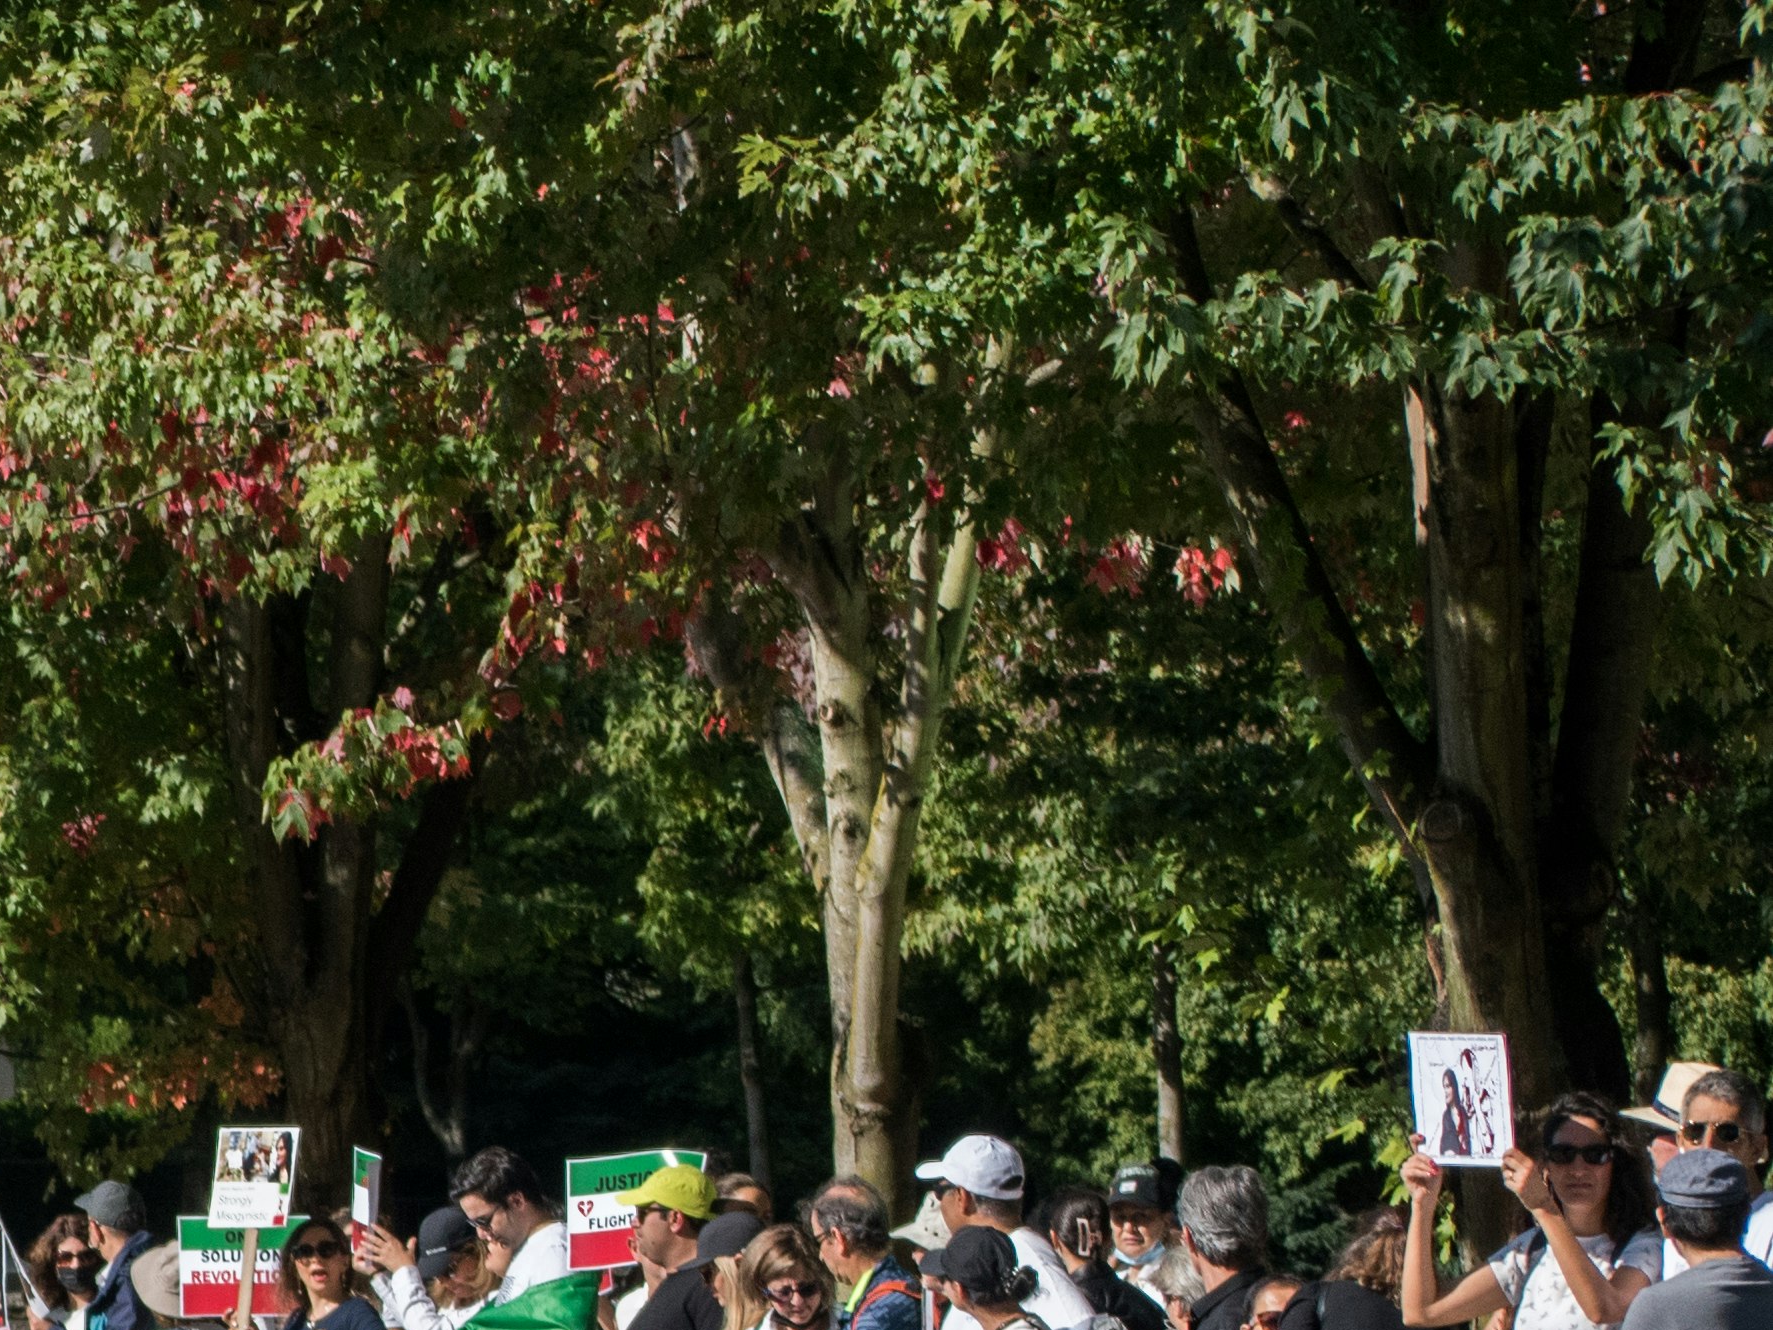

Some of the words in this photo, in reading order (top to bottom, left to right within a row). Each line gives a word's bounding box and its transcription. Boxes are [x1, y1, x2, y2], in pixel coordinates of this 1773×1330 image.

[594, 1170, 652, 1192] JUSTIC
[588, 1213, 634, 1230] FLIGHT
[225, 1230, 245, 1243] ON
